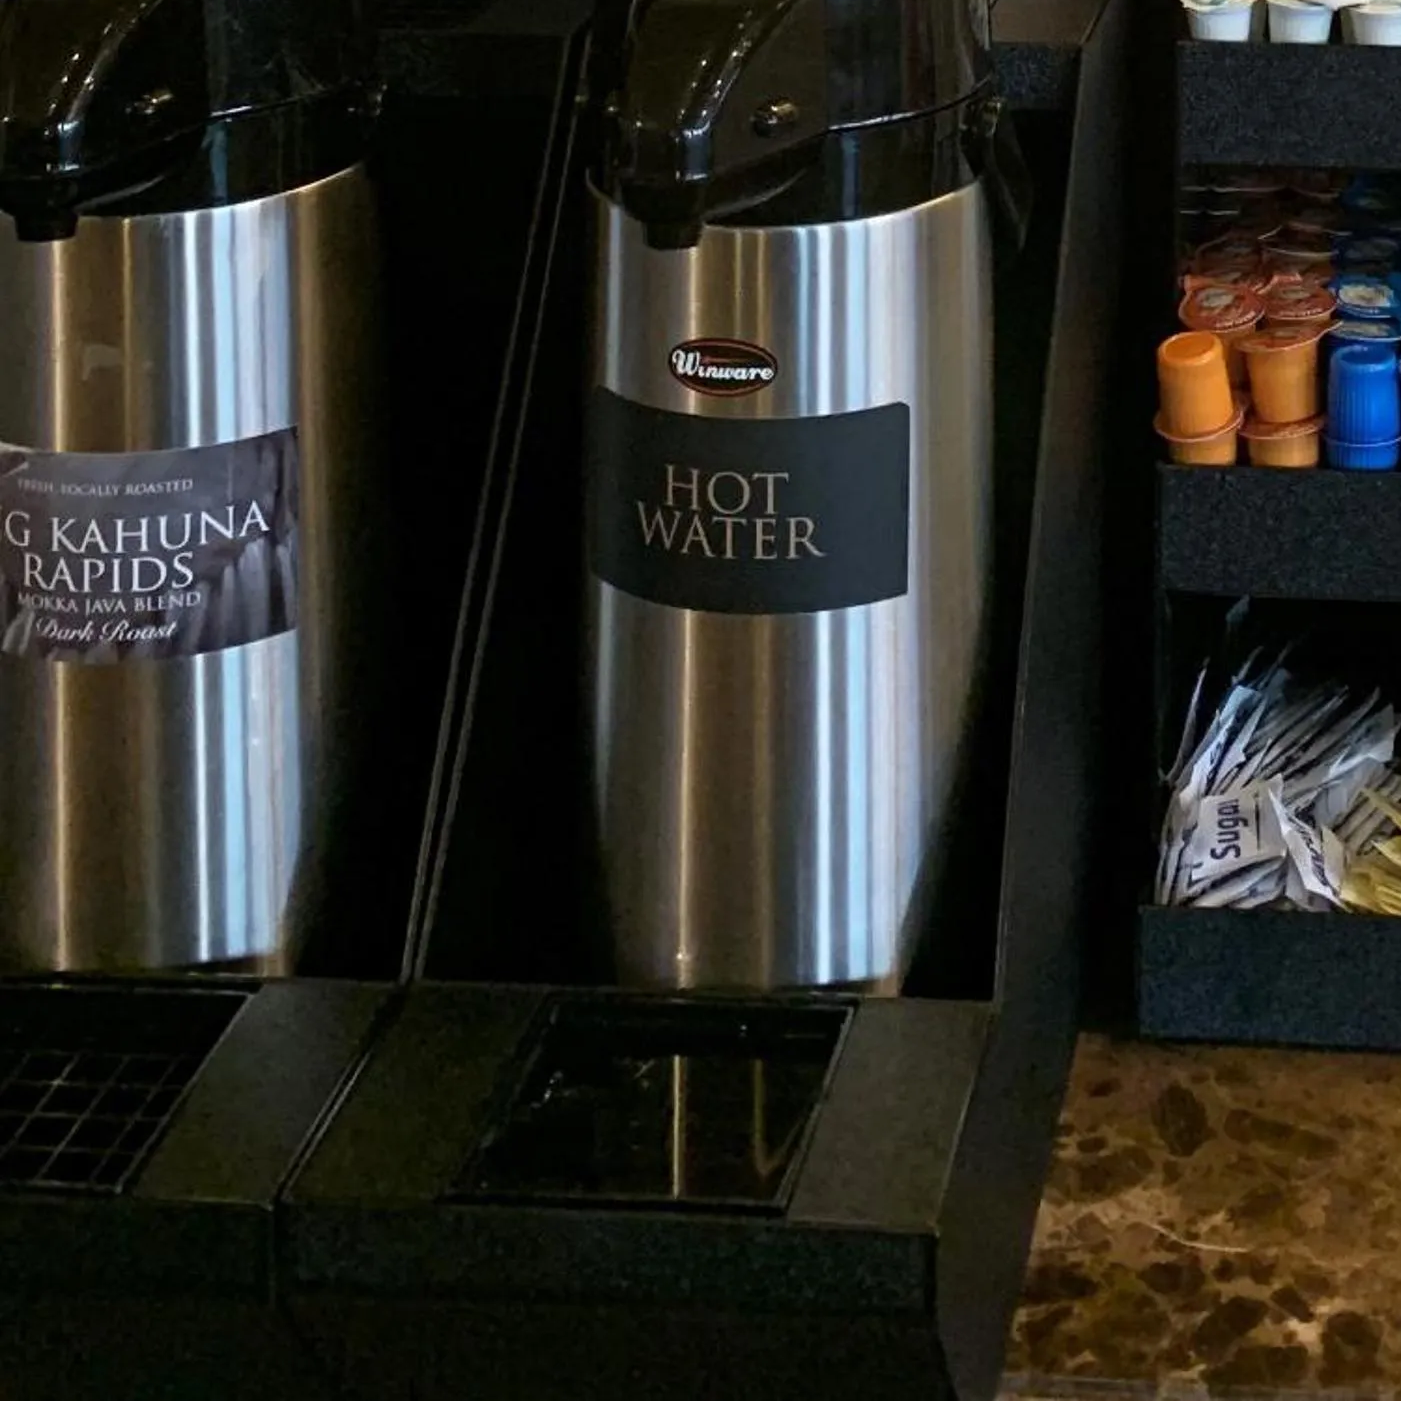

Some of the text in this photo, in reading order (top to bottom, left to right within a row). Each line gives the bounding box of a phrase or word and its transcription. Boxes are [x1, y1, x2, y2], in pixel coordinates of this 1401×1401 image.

[671, 350, 775, 381] Winware
[123, 478, 193, 496] ROASTED
[665, 464, 789, 515] HOT
[51, 499, 270, 553] KAHUNA
[637, 500, 829, 560] WATER
[23, 551, 194, 592] RAPIDS
[85, 597, 127, 615] JAVA
[133, 591, 201, 612] BLEND
[36, 618, 178, 641] Dark Roast
